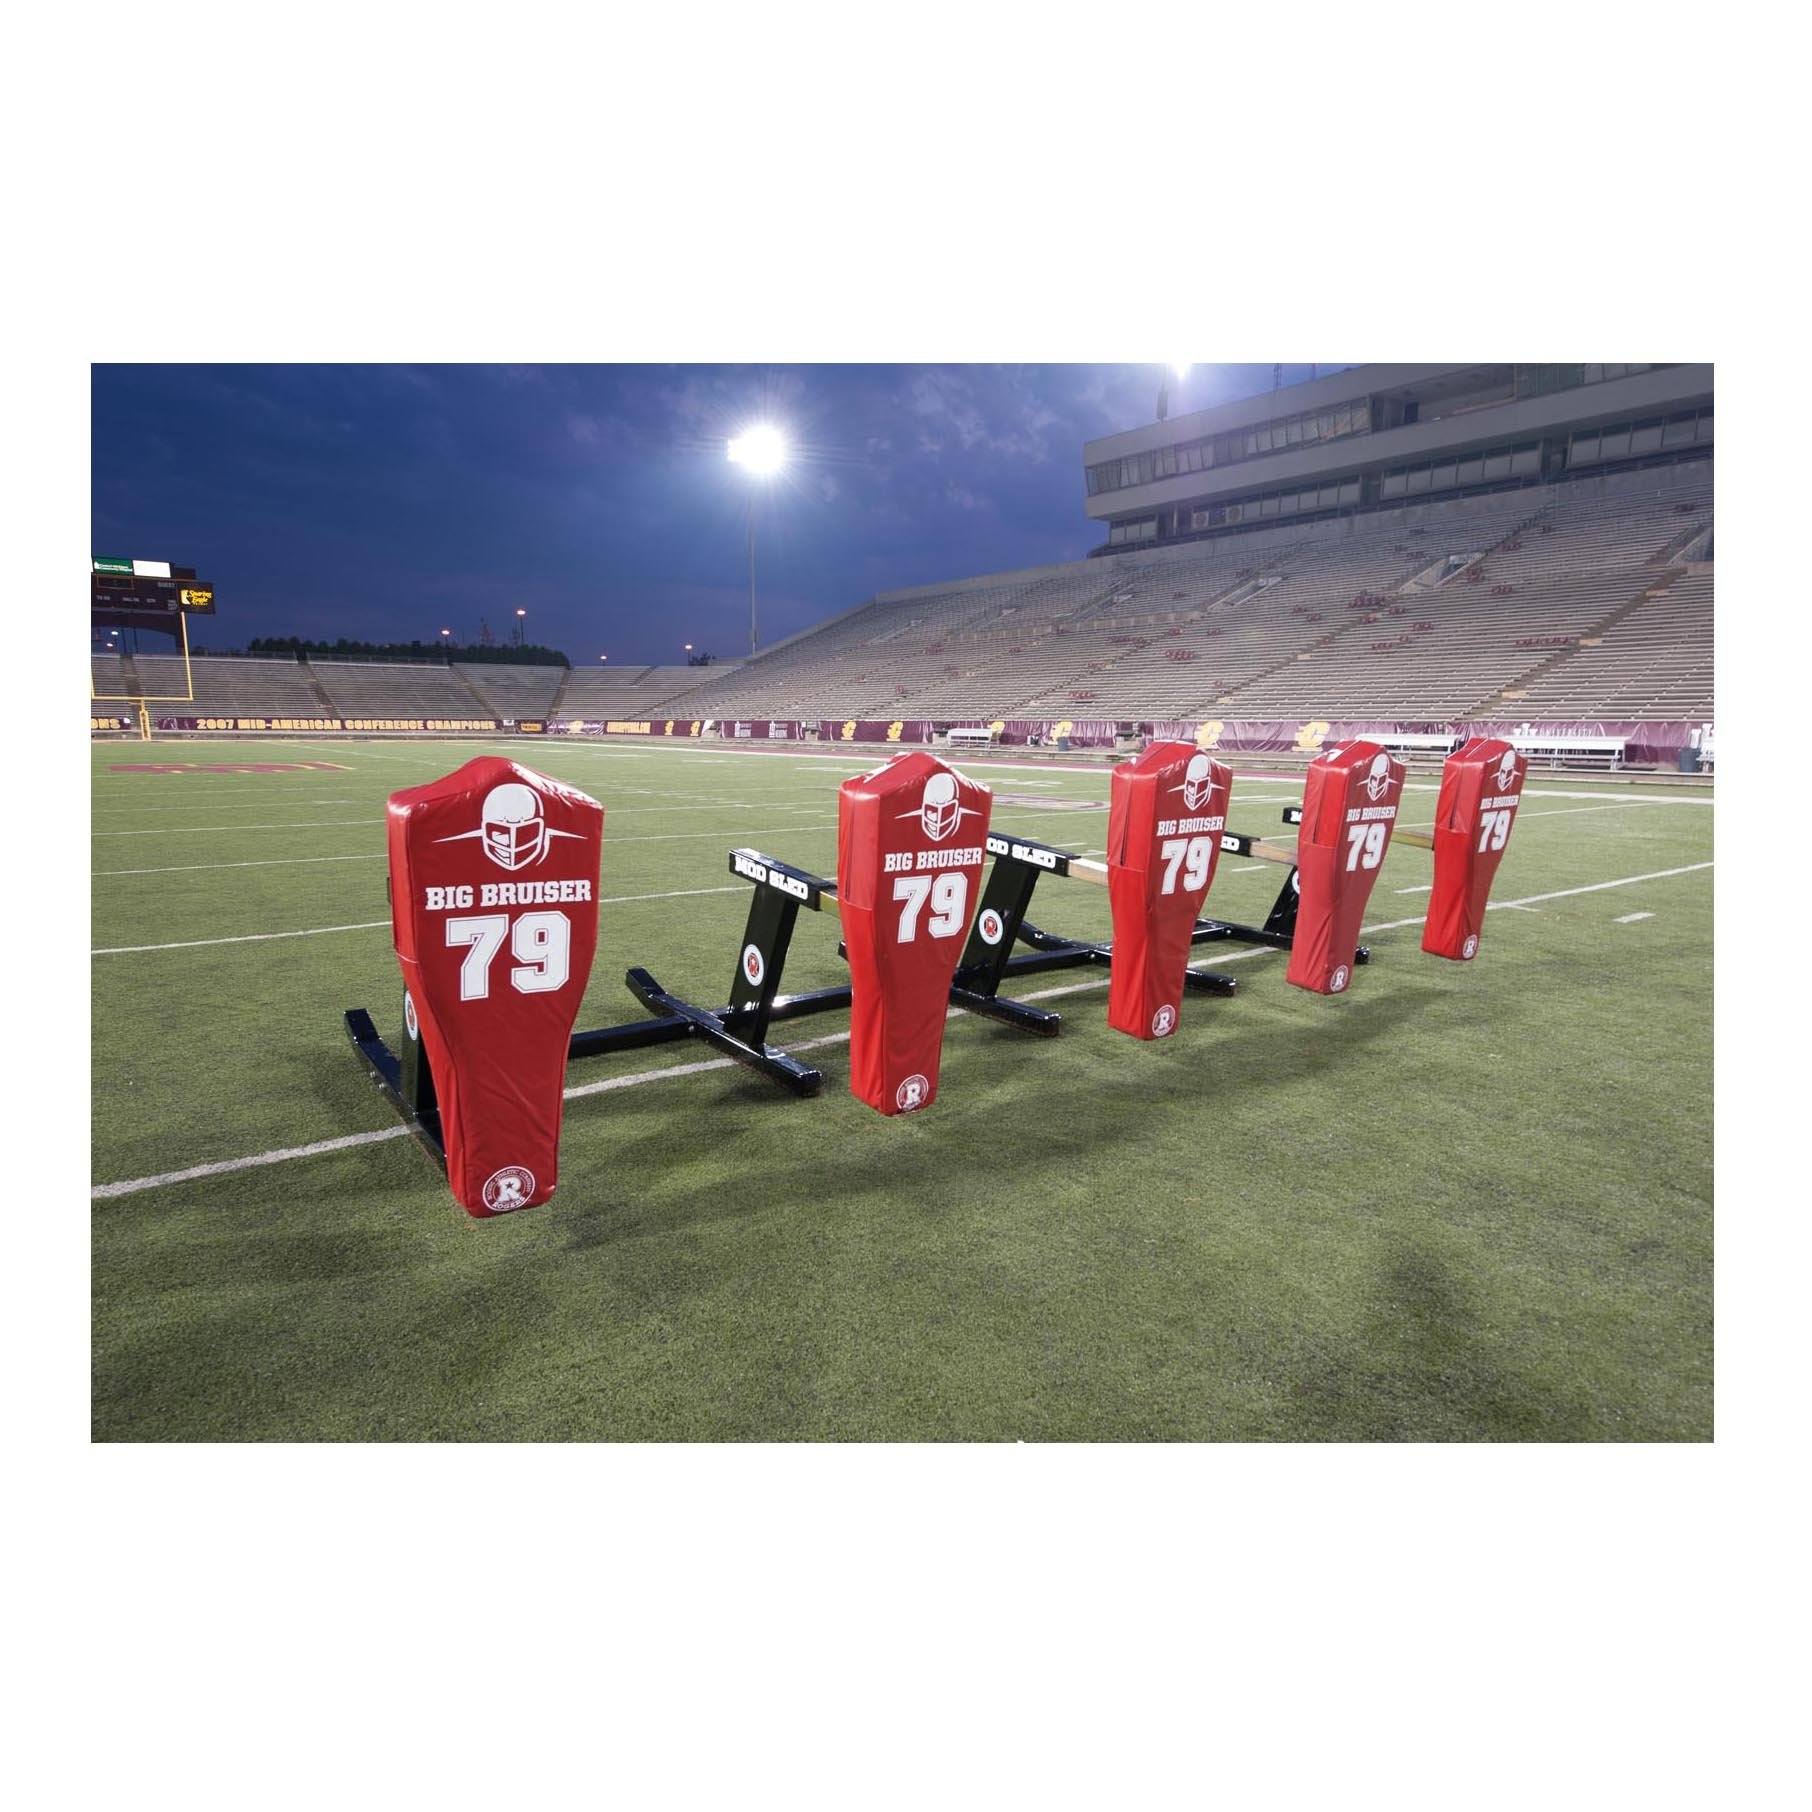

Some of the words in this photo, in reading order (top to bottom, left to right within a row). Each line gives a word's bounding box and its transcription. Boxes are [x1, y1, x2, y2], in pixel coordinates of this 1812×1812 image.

[196, 718, 234, 729] 2007
[237, 719, 341, 730] MID-AMERICAN
[345, 719, 424, 730] CONFERENCE
[426, 720, 496, 730] CHAMPIONS
[1156, 820, 1176, 837] BIG
[1178, 816, 1224, 835] BRUISER
[1346, 808, 1361, 822] BIG
[1361, 806, 1396, 821] BRUISER
[1478, 809, 1511, 853] 79
[883, 852, 913, 873] BIG
[915, 847, 982, 870] BRUISER
[986, 837, 1009, 856] OD
[1011, 843, 1057, 869] SLED
[1346, 823, 1387, 872] 79
[734, 856, 767, 883] MOD
[769, 869, 809, 900] SLED
[1160, 836, 1213, 895] 79
[425, 885, 474, 911] BIG
[480, 880, 592, 907] BRUISER
[892, 872, 968, 944] 79
[446, 910, 571, 1002] 79
[1335, 971, 1345, 986] R
[1157, 1012, 1171, 1029] R
[906, 1083, 921, 1104] R
[496, 1176, 522, 1202] R
